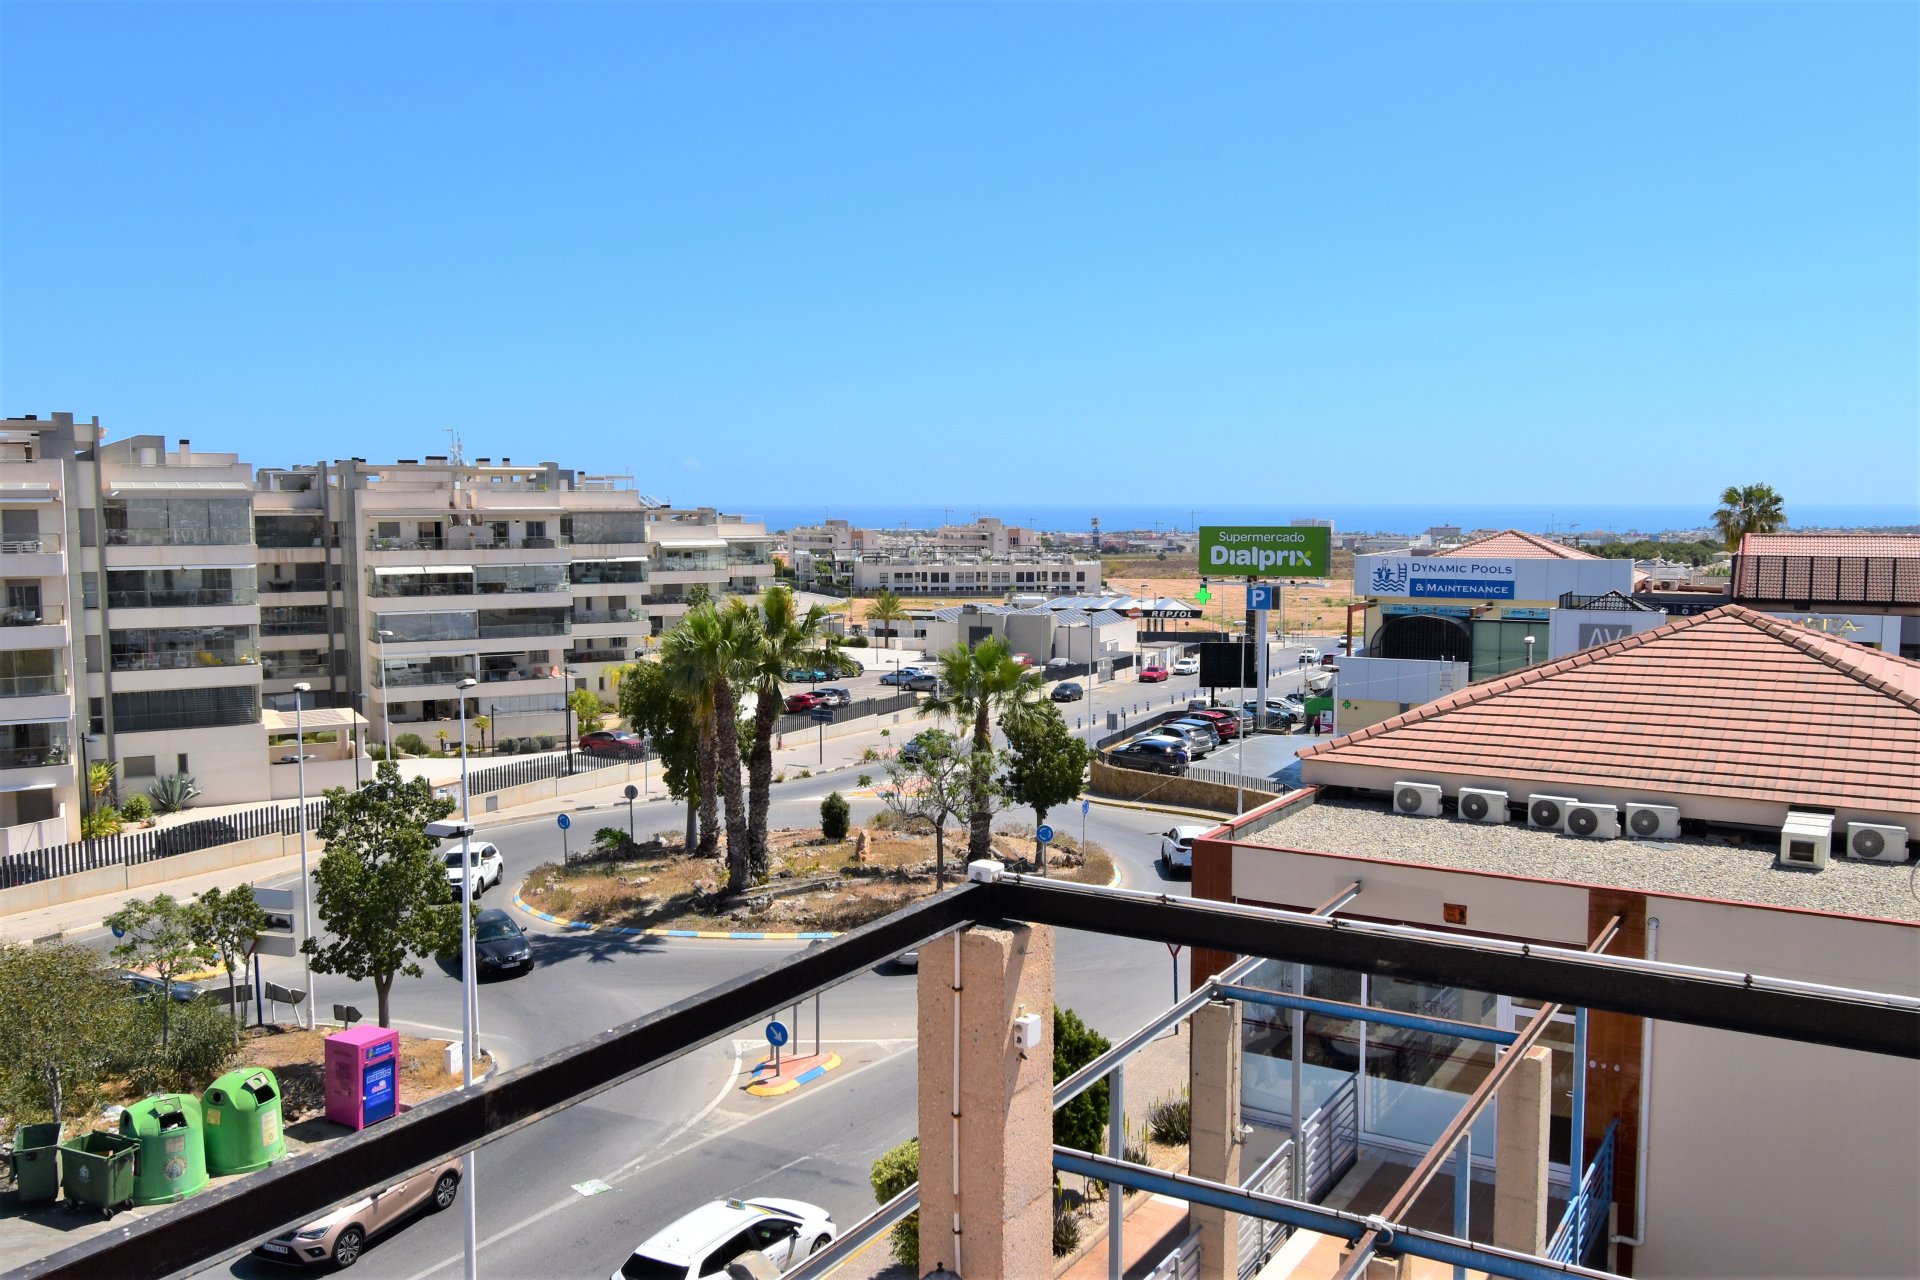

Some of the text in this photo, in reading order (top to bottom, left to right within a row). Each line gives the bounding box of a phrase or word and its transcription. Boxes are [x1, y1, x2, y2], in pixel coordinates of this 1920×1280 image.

[1219, 532, 1305, 544] Supermercado
[1210, 545, 1312, 571] Dialprix
[1415, 583, 1424, 592] &
[1252, 589, 1266, 607] P
[1151, 610, 1193, 618] REPSOL
